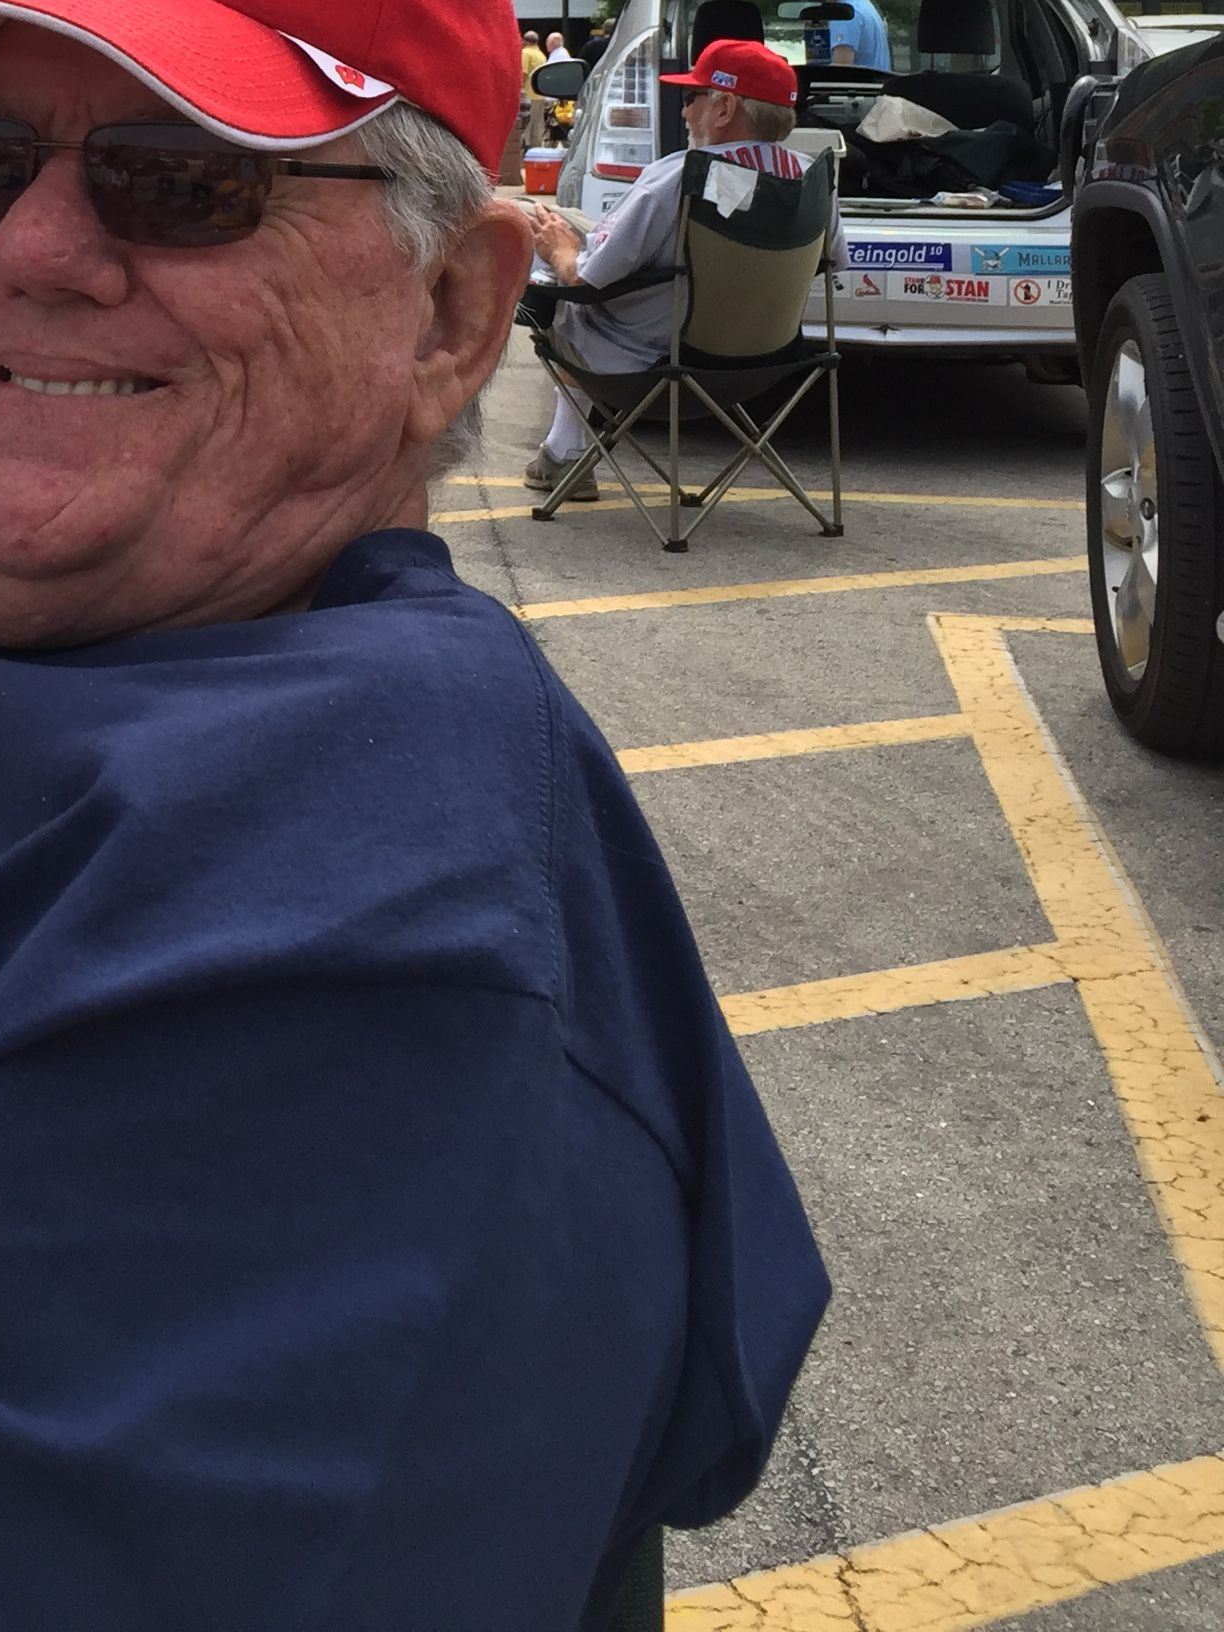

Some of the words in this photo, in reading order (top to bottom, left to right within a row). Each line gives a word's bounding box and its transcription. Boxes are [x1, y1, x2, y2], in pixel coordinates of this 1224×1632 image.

[724, 144, 805, 181] OLINA
[904, 283, 925, 295] FOR
[945, 279, 990, 298] STAN
